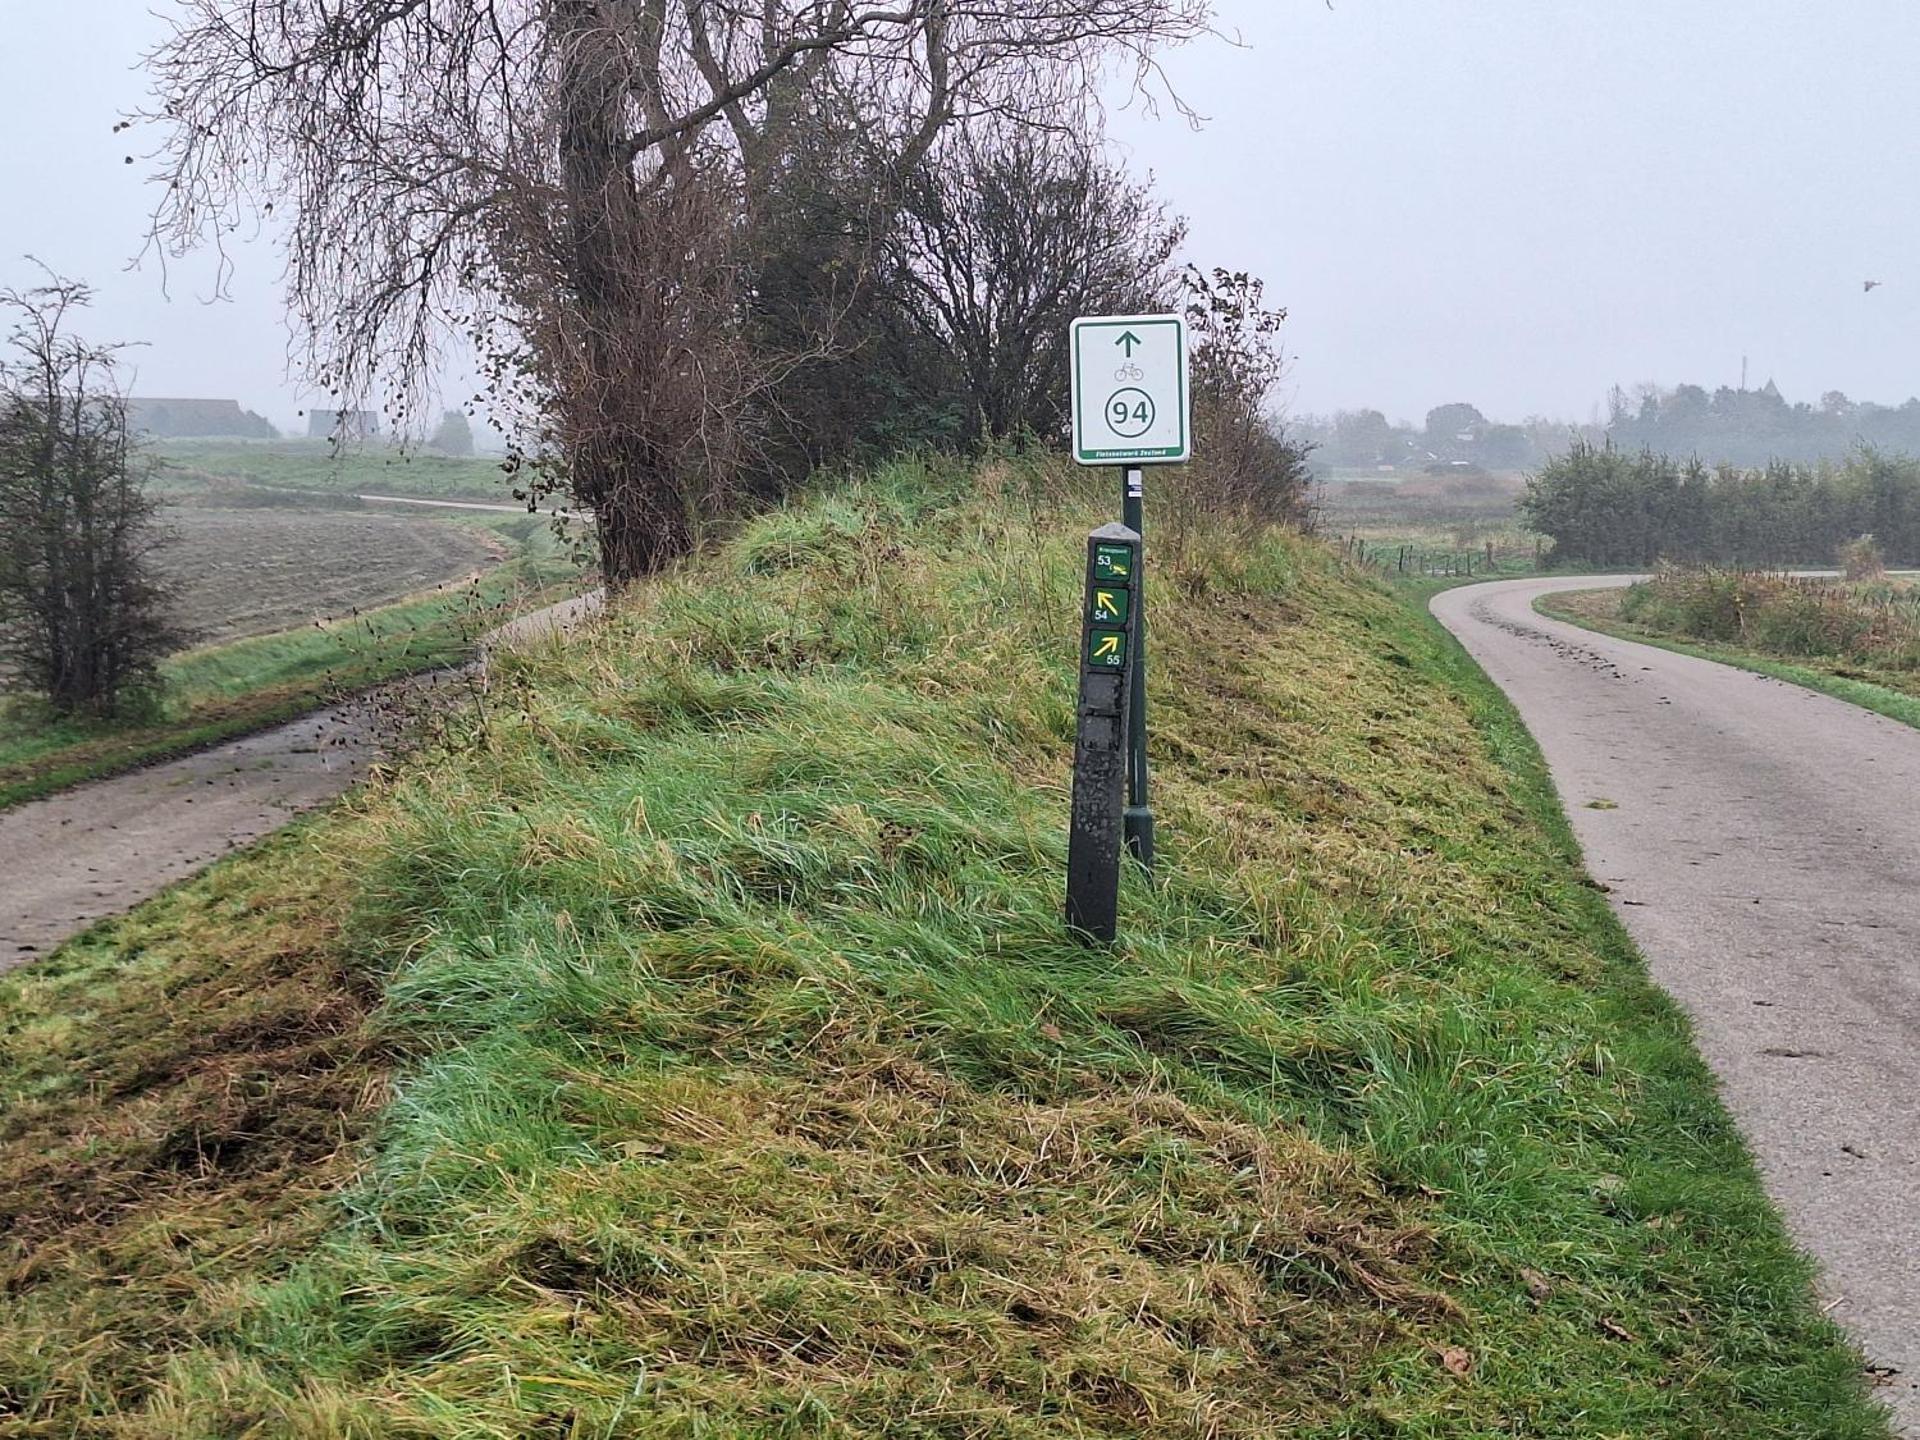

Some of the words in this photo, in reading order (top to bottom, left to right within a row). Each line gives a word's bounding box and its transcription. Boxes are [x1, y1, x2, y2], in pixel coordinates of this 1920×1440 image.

[1112, 401, 1149, 424] 94
[1097, 554, 1111, 566] 53
[1094, 609, 1108, 620] 54
